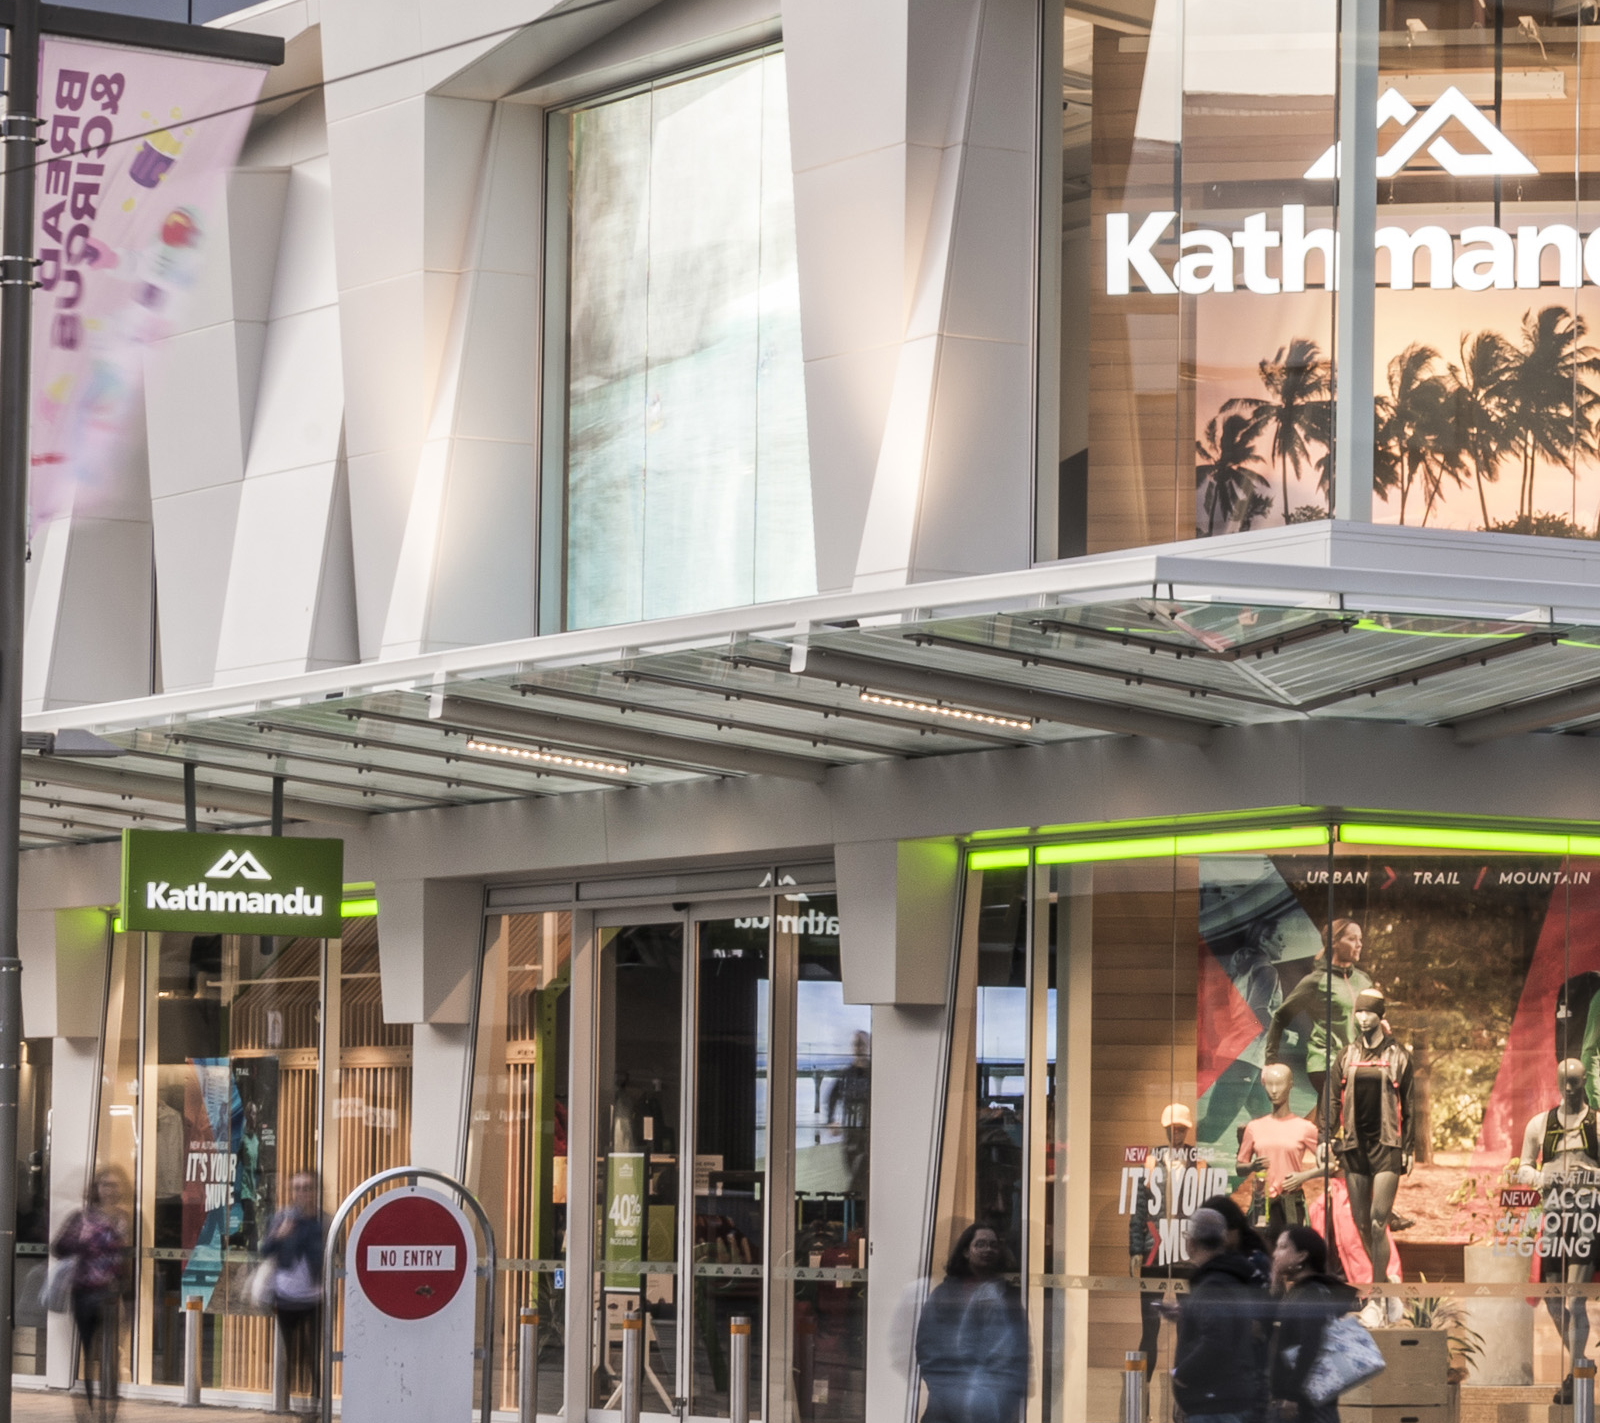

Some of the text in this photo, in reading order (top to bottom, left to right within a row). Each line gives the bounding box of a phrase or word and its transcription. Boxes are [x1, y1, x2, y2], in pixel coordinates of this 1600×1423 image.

[1306, 870, 1368, 885] URBAN
[1413, 871, 1461, 885] TRAIL
[1499, 871, 1591, 885] MOUNTAIN
[146, 881, 323, 917] Kathmandu
[235, 1067, 249, 1076] TRAIL
[1125, 1147, 1148, 1162] NEW
[186, 1153, 237, 1183] IT'S YOUR
[1118, 1167, 1164, 1216] IT'S
[1501, 1191, 1536, 1206] NEW
[609, 1194, 641, 1226] 40%
[1493, 1236, 1592, 1258] LEGGING
[380, 1250, 443, 1267] NO ENTRY
